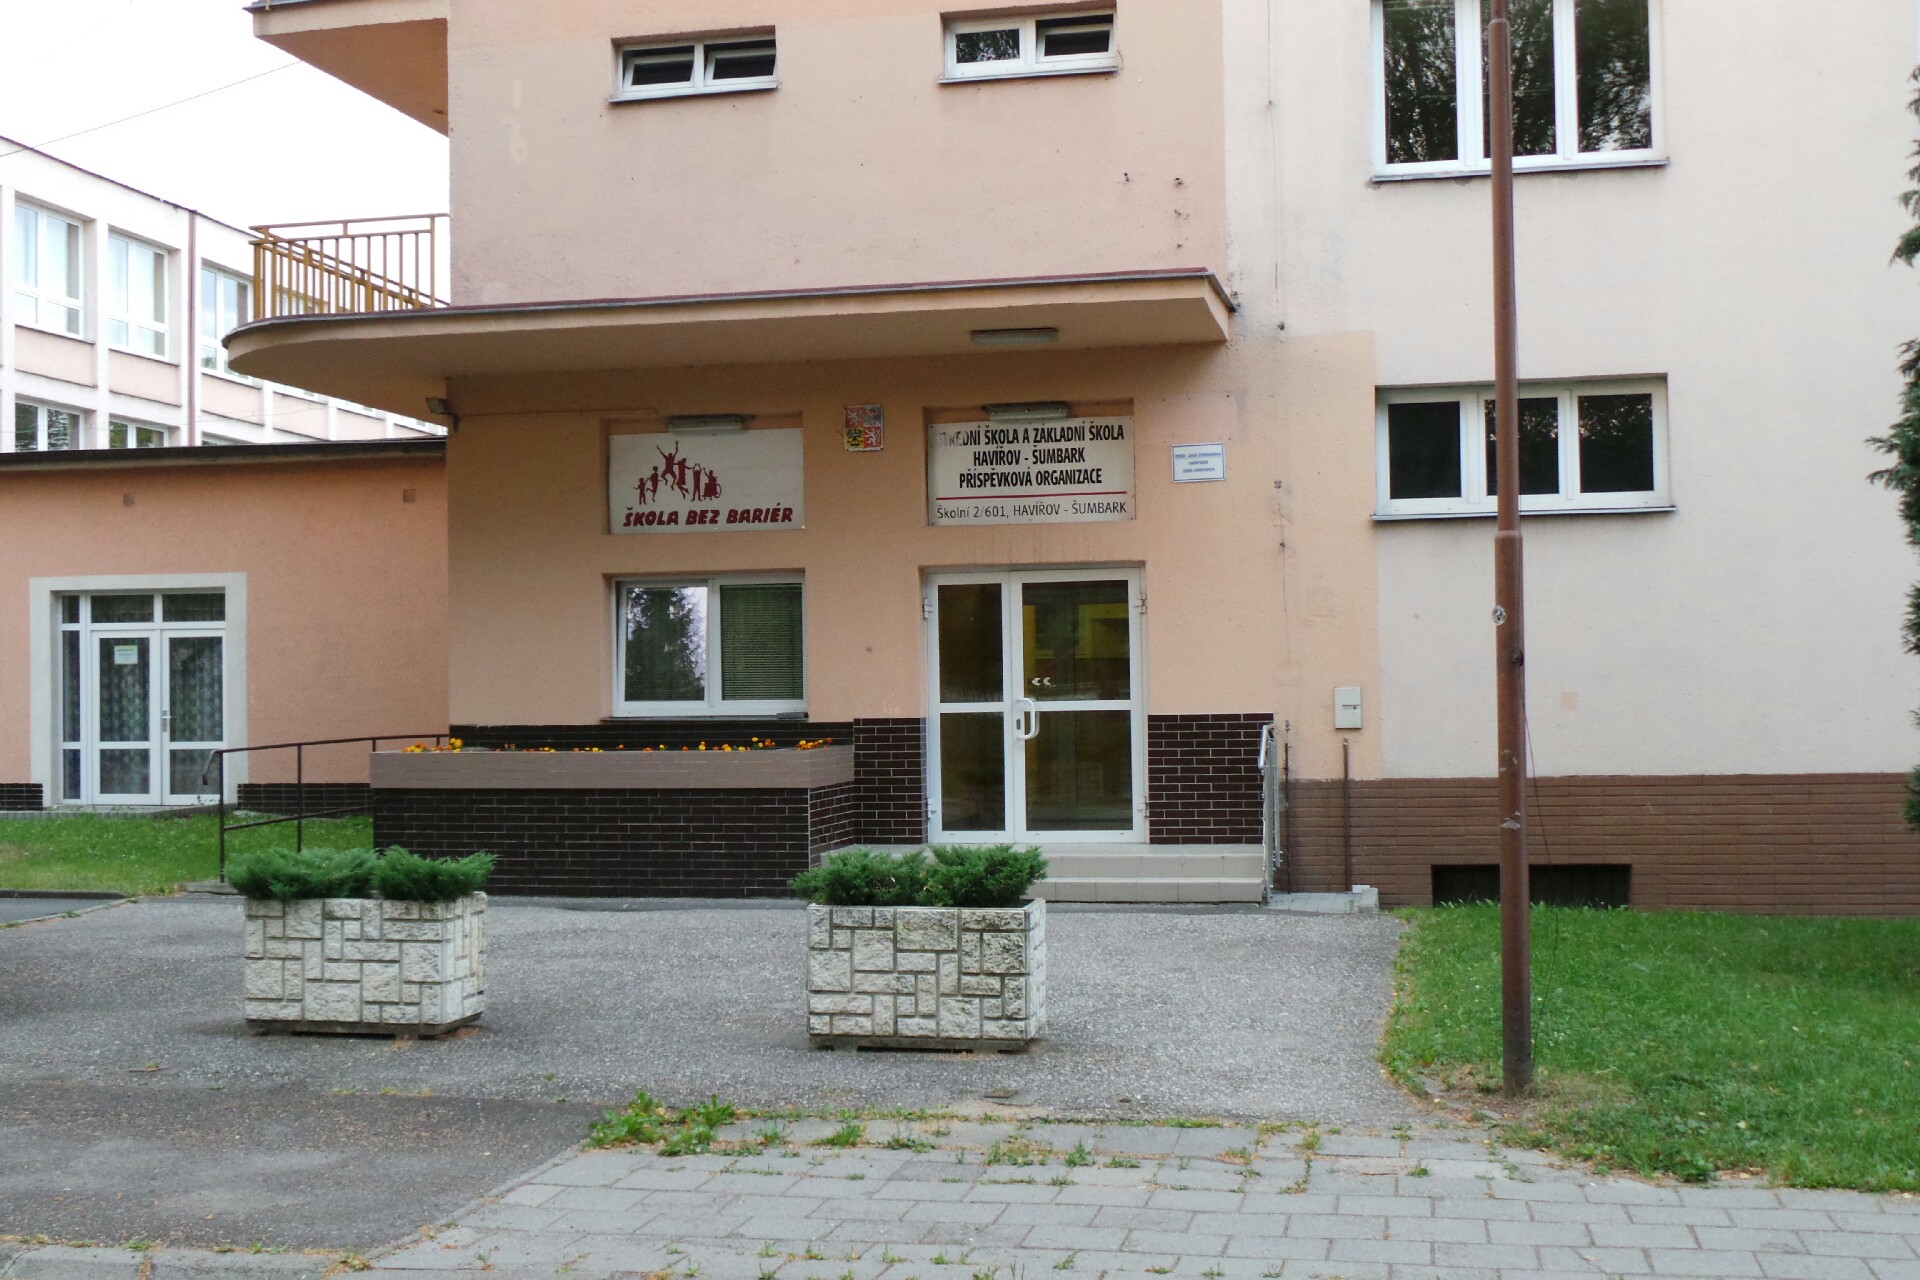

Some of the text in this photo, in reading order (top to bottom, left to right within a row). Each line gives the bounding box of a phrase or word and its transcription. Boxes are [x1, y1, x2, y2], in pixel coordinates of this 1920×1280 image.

[984, 425, 1018, 446] ŠKOLA
[1022, 429, 1030, 444] A
[1033, 421, 1086, 443] ZÁKLADNÍ
[1089, 420, 1124, 441] ŠKOLA
[973, 446, 1021, 467] HAVÍŘOV
[1032, 444, 1086, 465] ŠUMBARK
[959, 467, 1103, 489] PŘÍSPĚVKOVÁ ORGANIZACE
[623, 502, 793, 527] ŠKOLA BEZ BARIÉR
[937, 504, 970, 519] Školní
[973, 505, 1009, 519] 2/601,
[1013, 500, 1061, 517] HAVÍŘOV
[1072, 499, 1127, 515] ŠUMBARK
